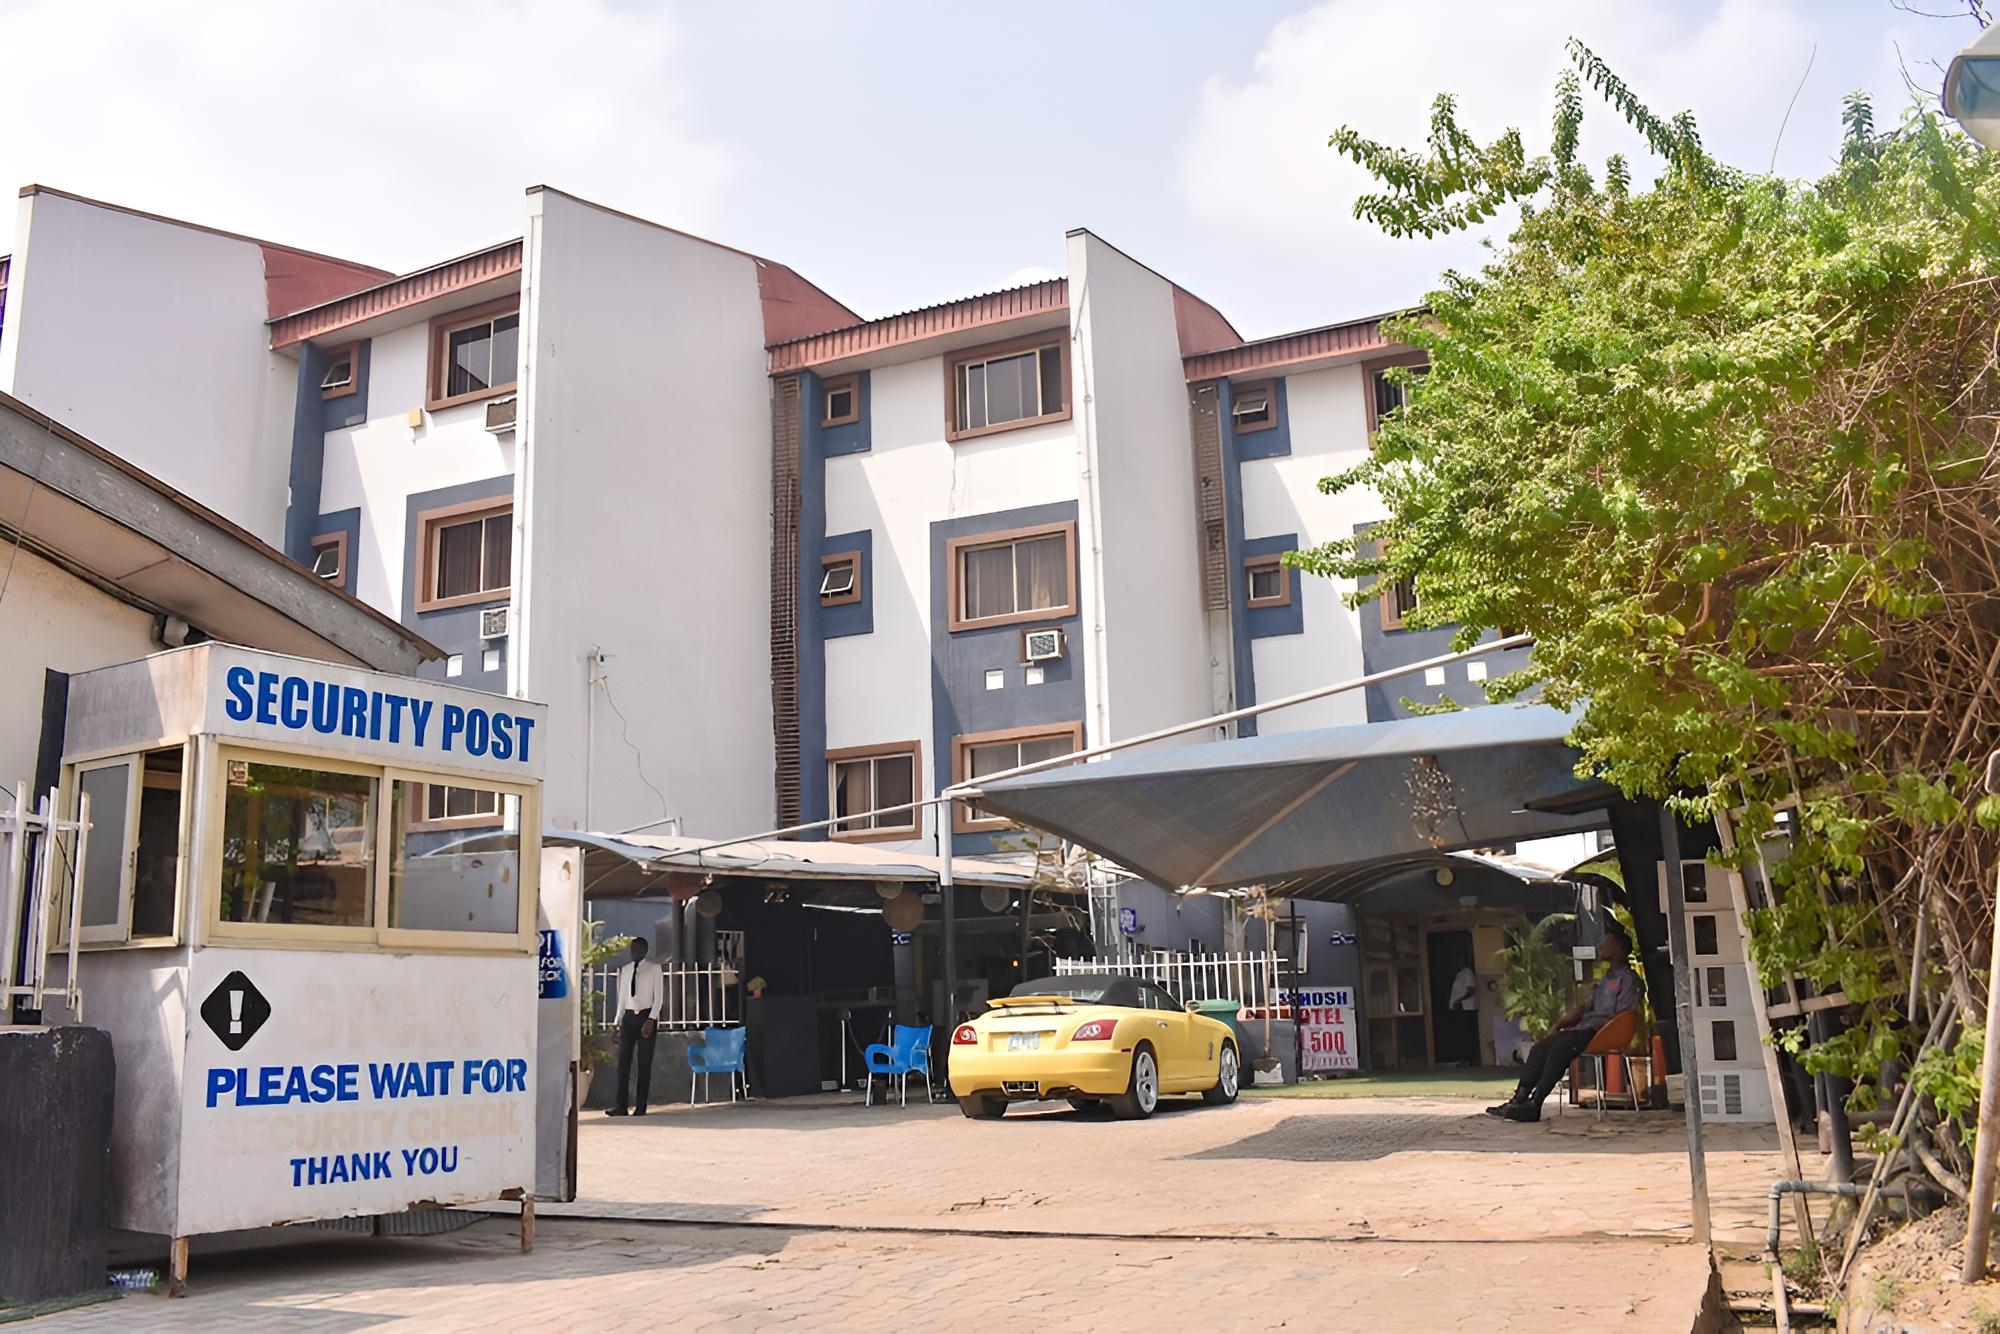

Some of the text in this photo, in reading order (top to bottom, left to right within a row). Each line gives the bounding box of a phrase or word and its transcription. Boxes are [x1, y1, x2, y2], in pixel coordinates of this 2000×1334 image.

[225, 666, 535, 763] SECURITY POST
[1299, 1007, 1345, 1025] OTEL
[206, 1058, 527, 1108] PLEASE WAIT FOR
[290, 1146, 459, 1187] THANK YOU
